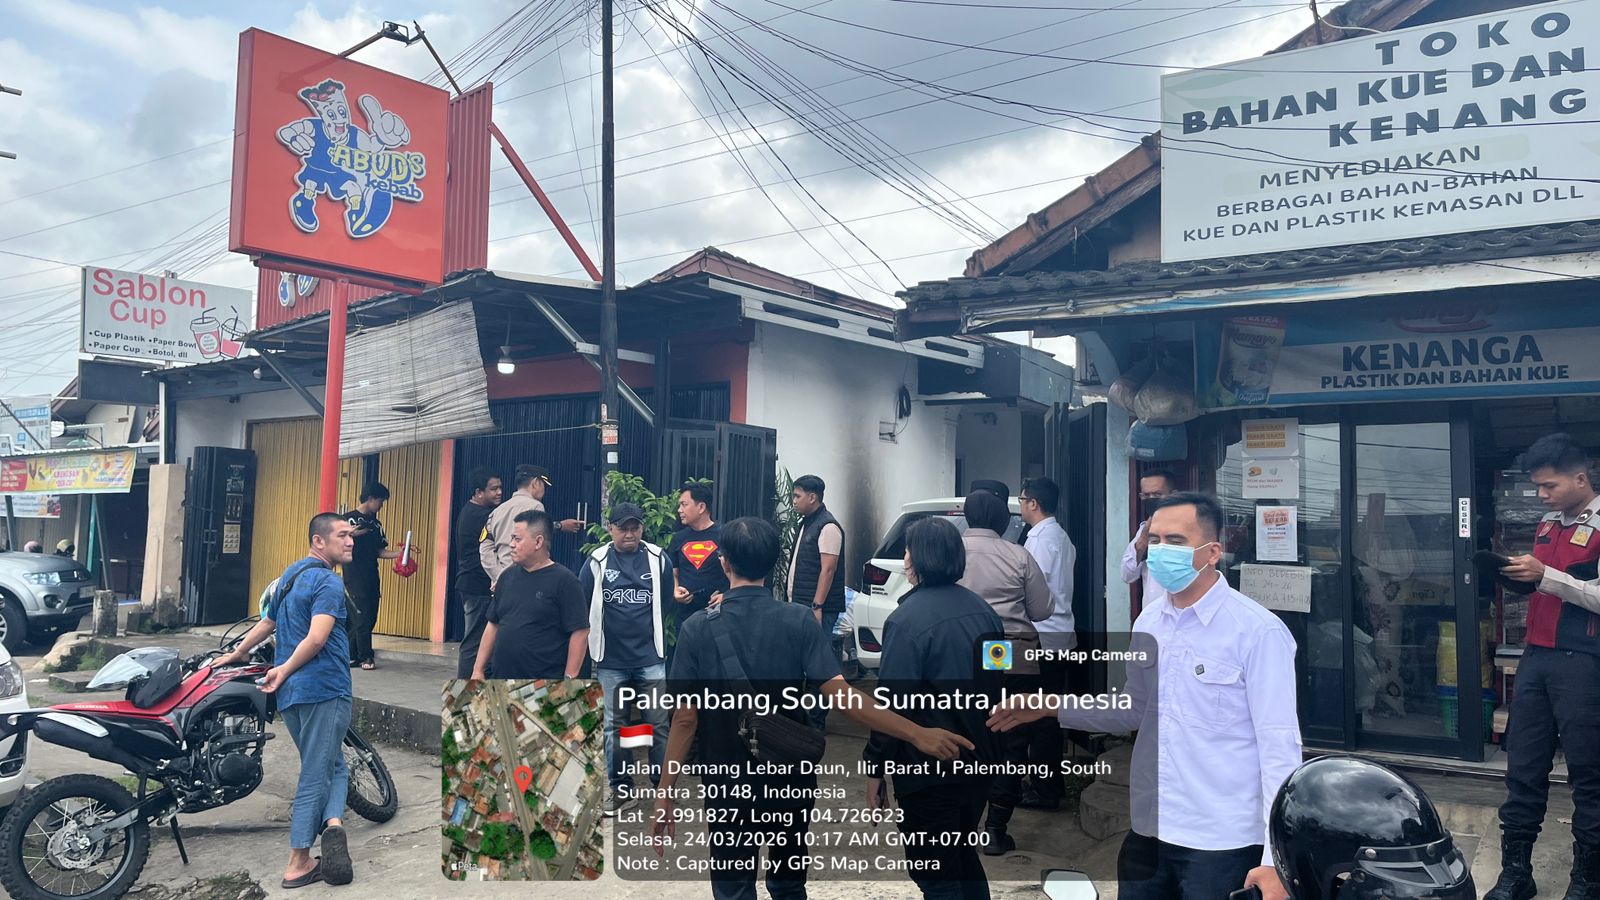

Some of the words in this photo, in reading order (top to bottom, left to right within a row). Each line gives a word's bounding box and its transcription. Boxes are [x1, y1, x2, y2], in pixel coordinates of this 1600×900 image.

[1182, 88, 1337, 135] BAHAN
[1358, 69, 1448, 107] KUE
[1472, 47, 1585, 88] DAN
[331, 145, 425, 184] ABUD'S
[1259, 145, 1481, 190] MENYEDIAKAN
[365, 173, 422, 199] kebab
[1217, 191, 1332, 218] BERBAGAI
[1341, 166, 1539, 203] BAHAN-BAHAN
[1183, 225, 1225, 242] KUE
[1231, 219, 1279, 237] DAN
[1286, 207, 1385, 232] PLASTIK
[1393, 191, 1523, 219] KEMASAN
[1532, 185, 1584, 203] DLL
[92, 268, 206, 308] Sablon
[110, 299, 167, 330] Cup
[93, 330, 112, 339] Cup
[114, 332, 146, 343] Plastik
[153, 338, 176, 348] Paper
[178, 340, 197, 350] Bowl
[93, 341, 120, 352] Paper
[123, 344, 141, 354] Cup
[152, 348, 176, 358] Botol,
[1342, 334, 1544, 372] KENANGA
[1321, 373, 1400, 389] PLASTIK
[1403, 371, 1444, 386] DAN
[1450, 367, 1522, 384] BAHAN
[1528, 365, 1569, 381] KUE
